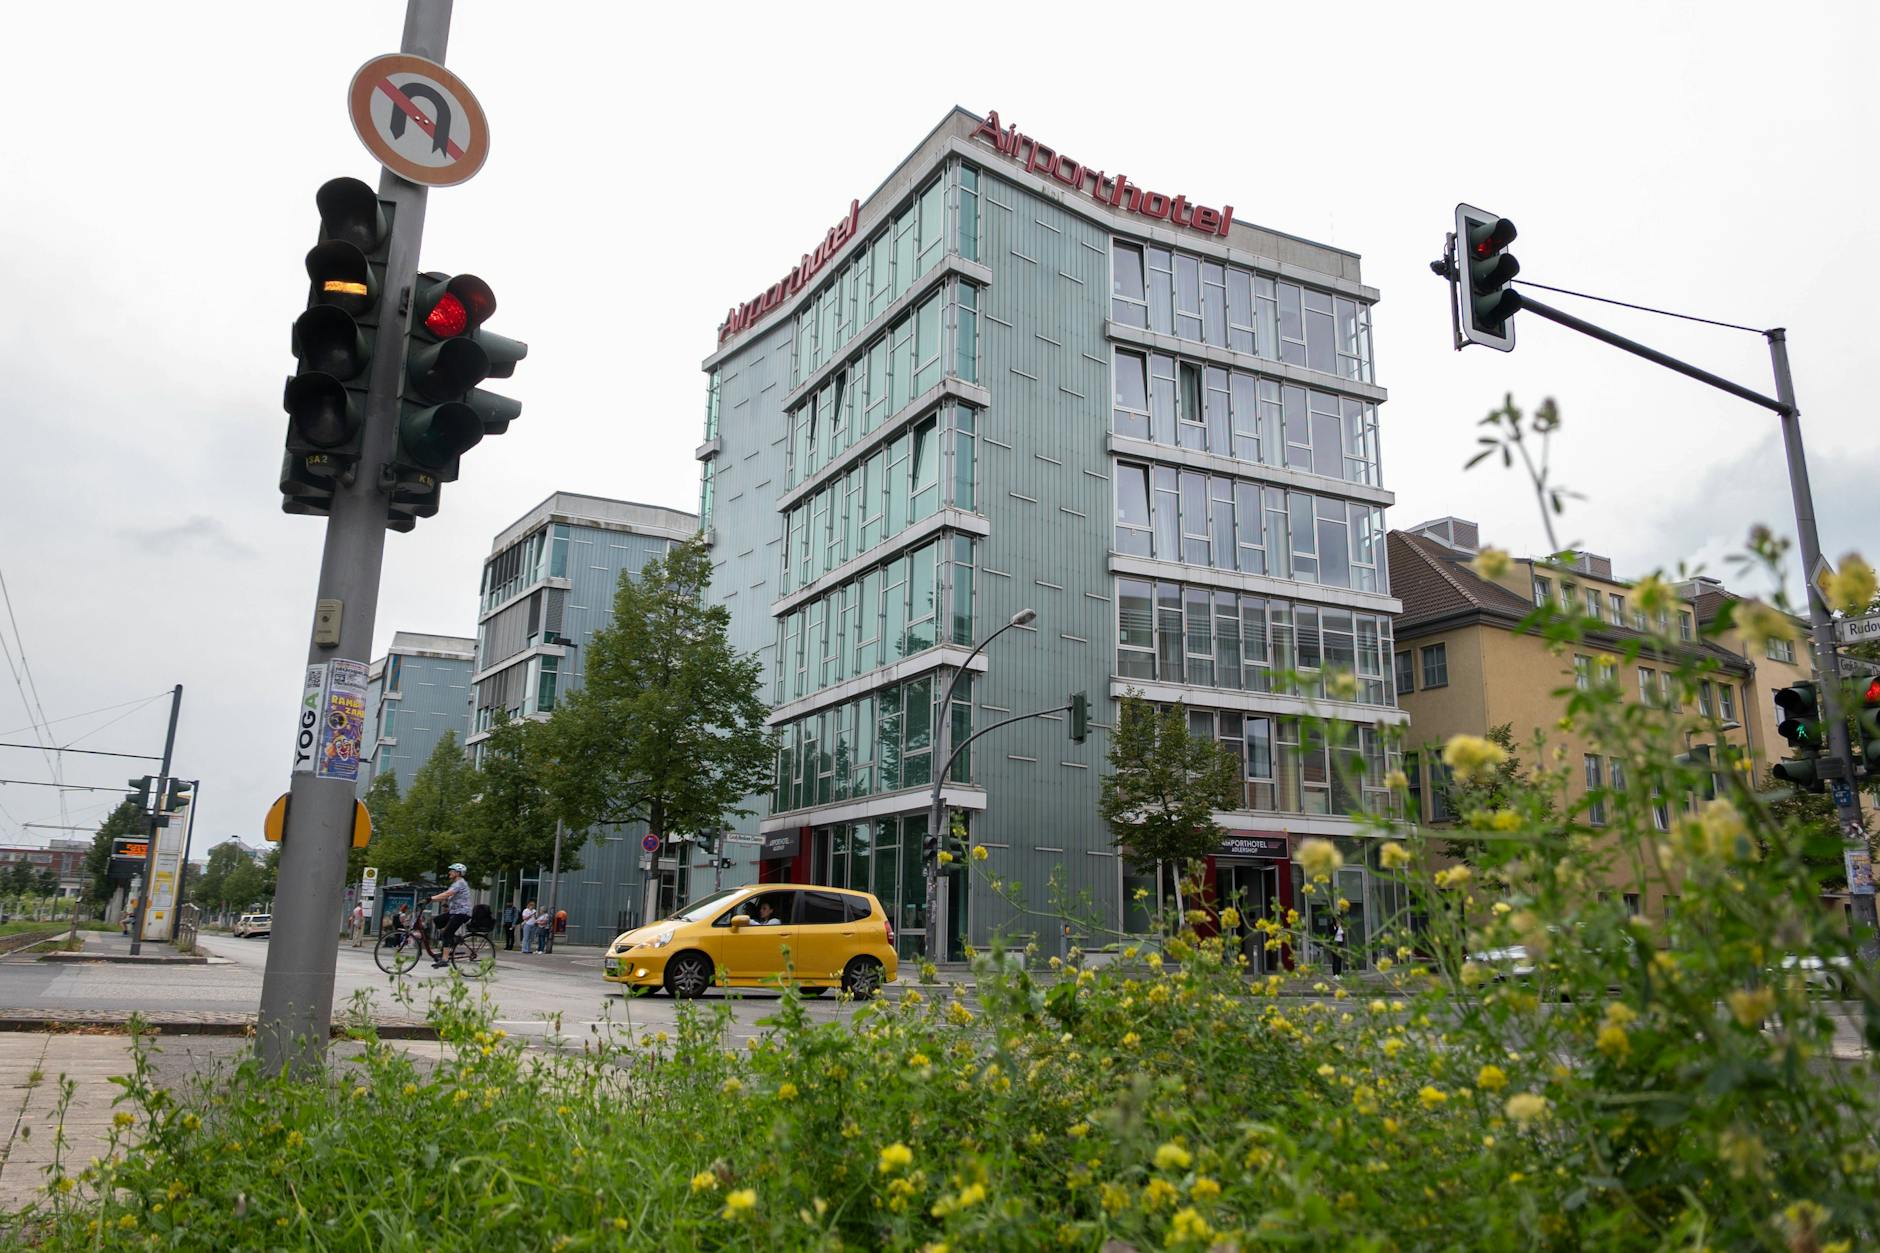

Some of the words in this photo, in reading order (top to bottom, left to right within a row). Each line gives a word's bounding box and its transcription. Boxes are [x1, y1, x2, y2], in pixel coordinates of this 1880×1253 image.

[970, 109, 1233, 238] Airporthotel
[719, 198, 860, 342] Airporthotel
[295, 691, 320, 767] YOGA
[344, 706, 365, 719] ZAM
